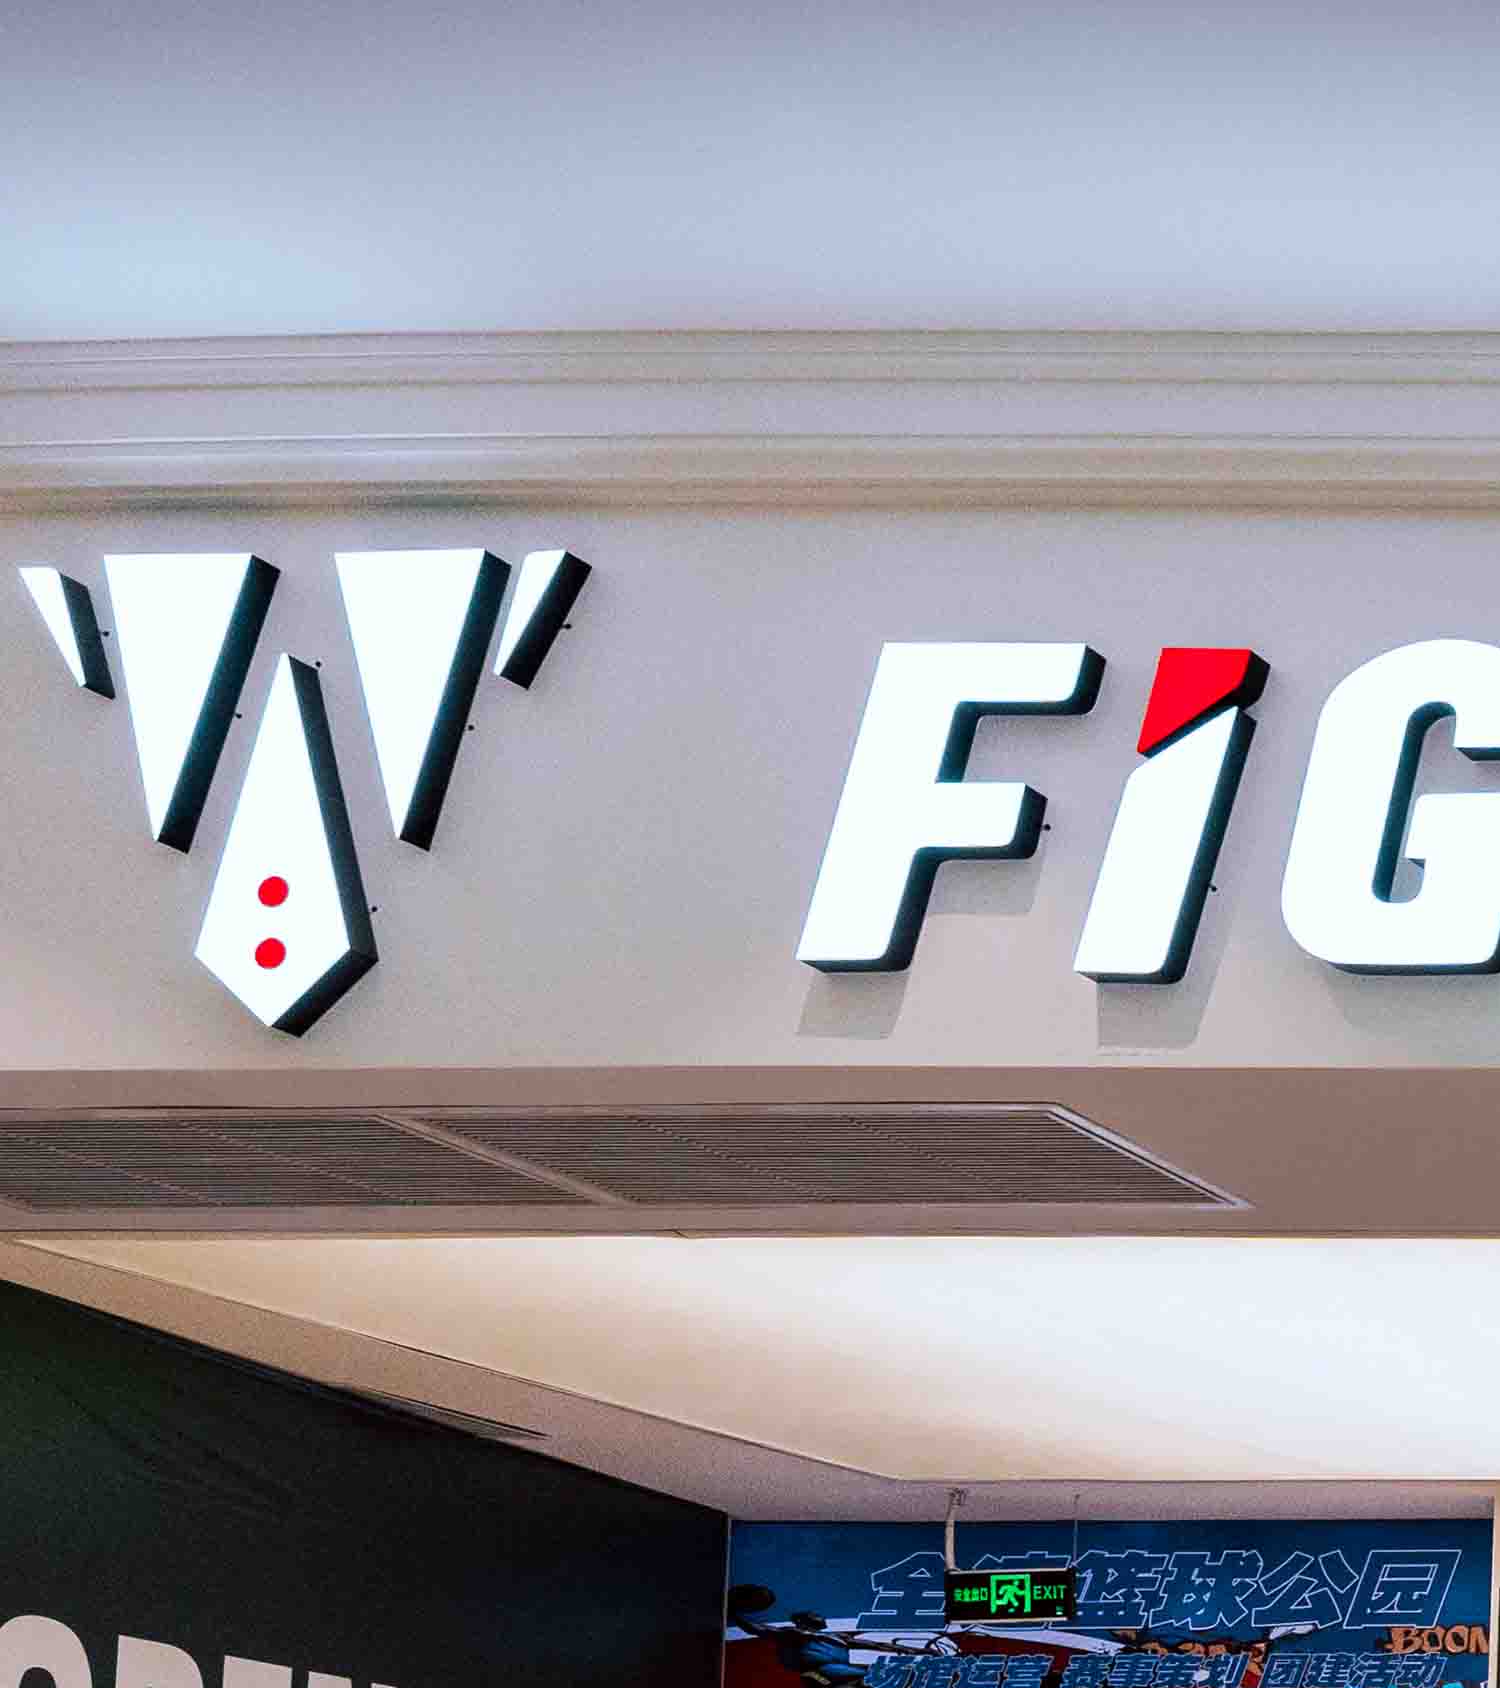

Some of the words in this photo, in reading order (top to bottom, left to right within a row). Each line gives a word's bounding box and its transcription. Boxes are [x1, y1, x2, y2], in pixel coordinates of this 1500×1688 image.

[855, 1549, 1461, 1631] 全篮球公园
[1032, 1585, 1078, 1600] EXIT
